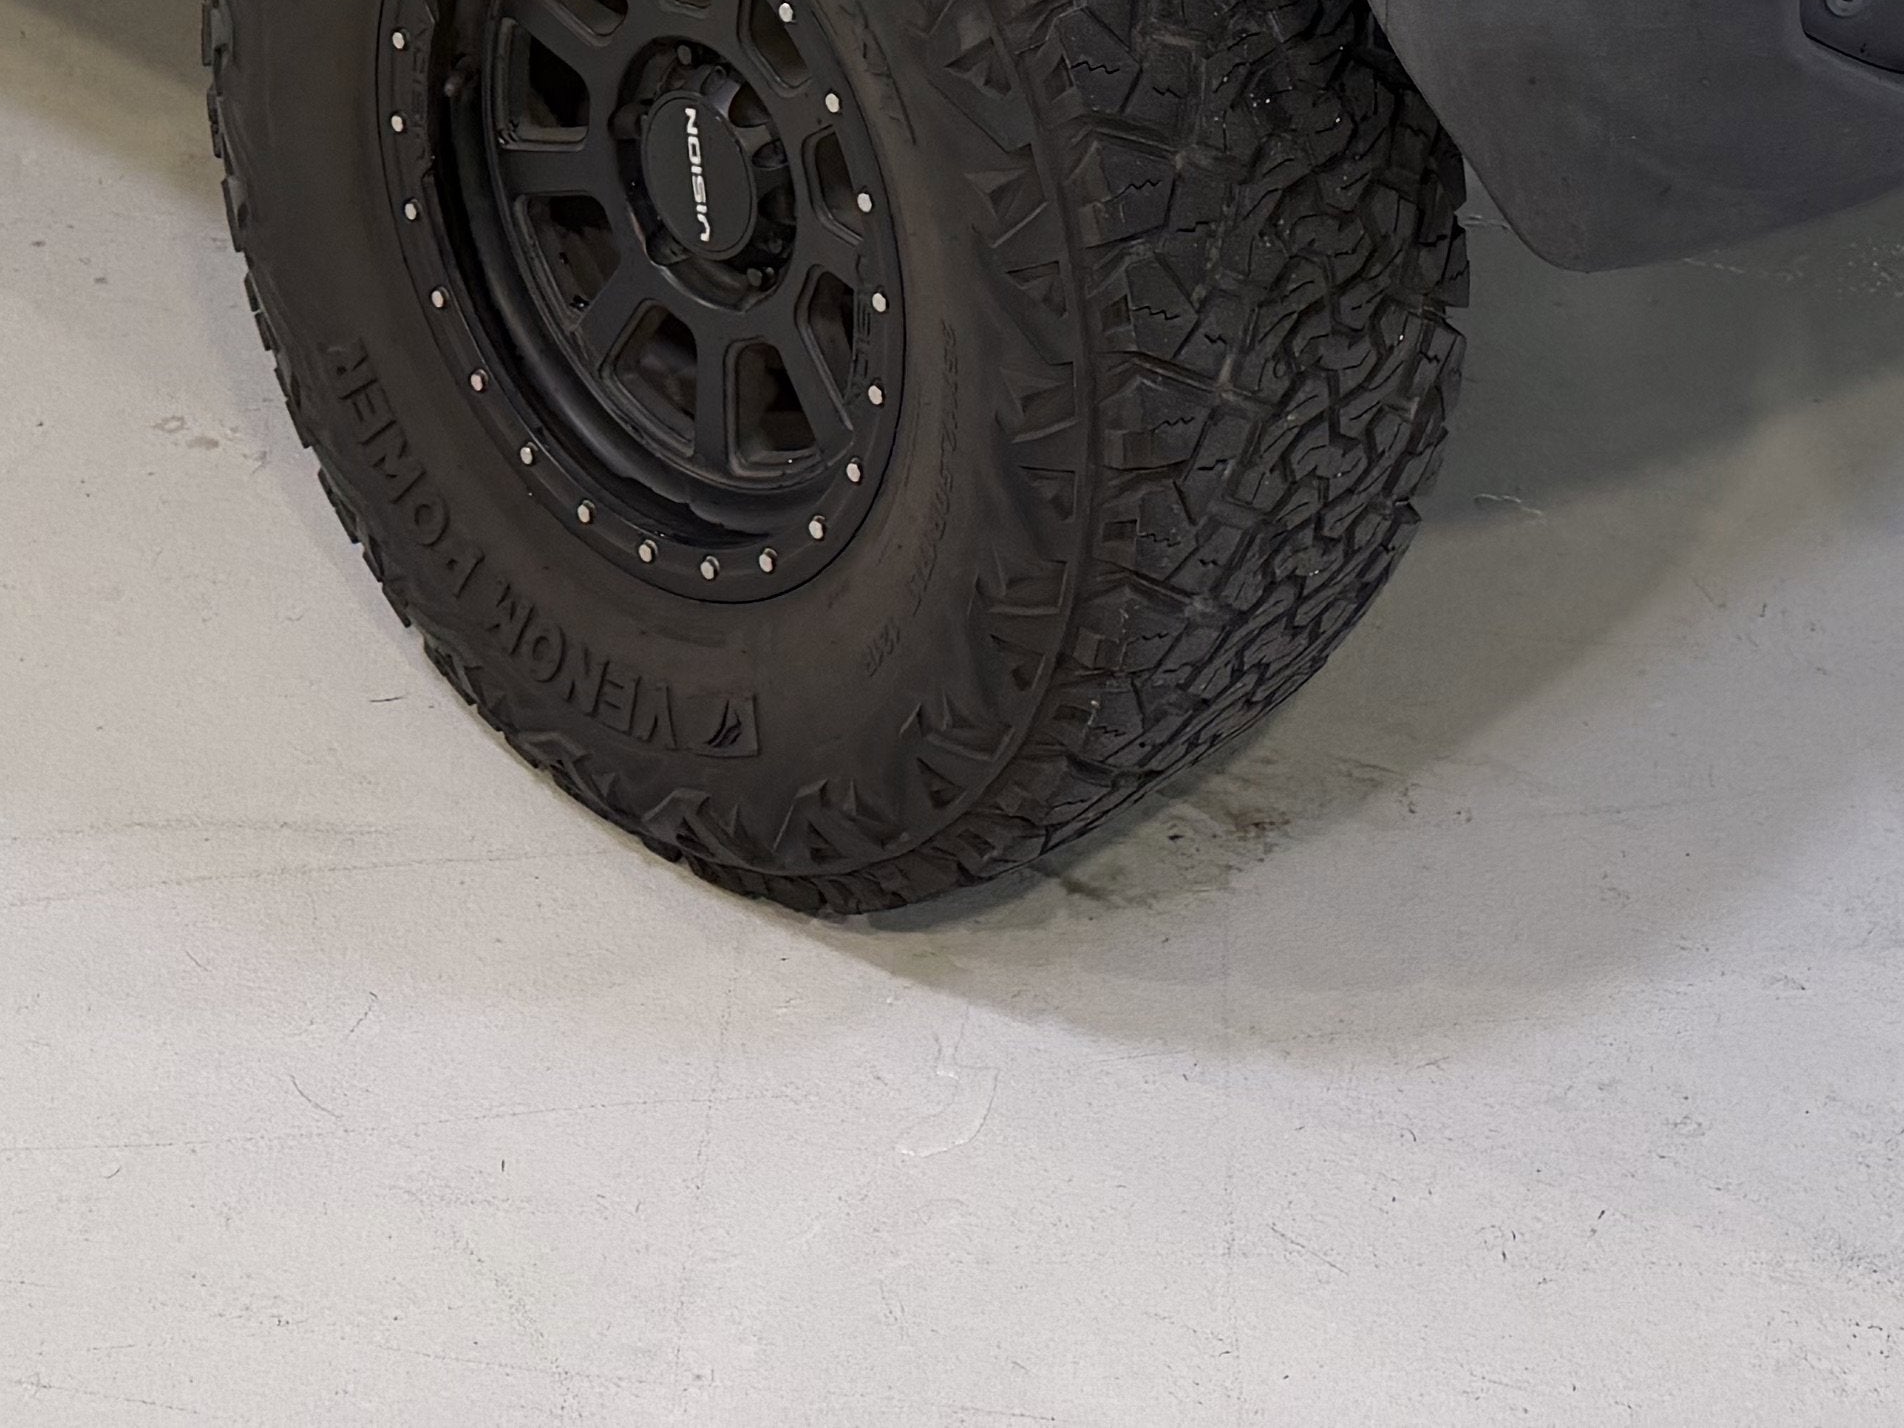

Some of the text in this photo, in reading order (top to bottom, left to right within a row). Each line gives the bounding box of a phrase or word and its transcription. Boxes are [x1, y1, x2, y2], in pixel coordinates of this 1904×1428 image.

[685, 108, 711, 242] VISION
[318, 337, 679, 751] VENOM POWER
